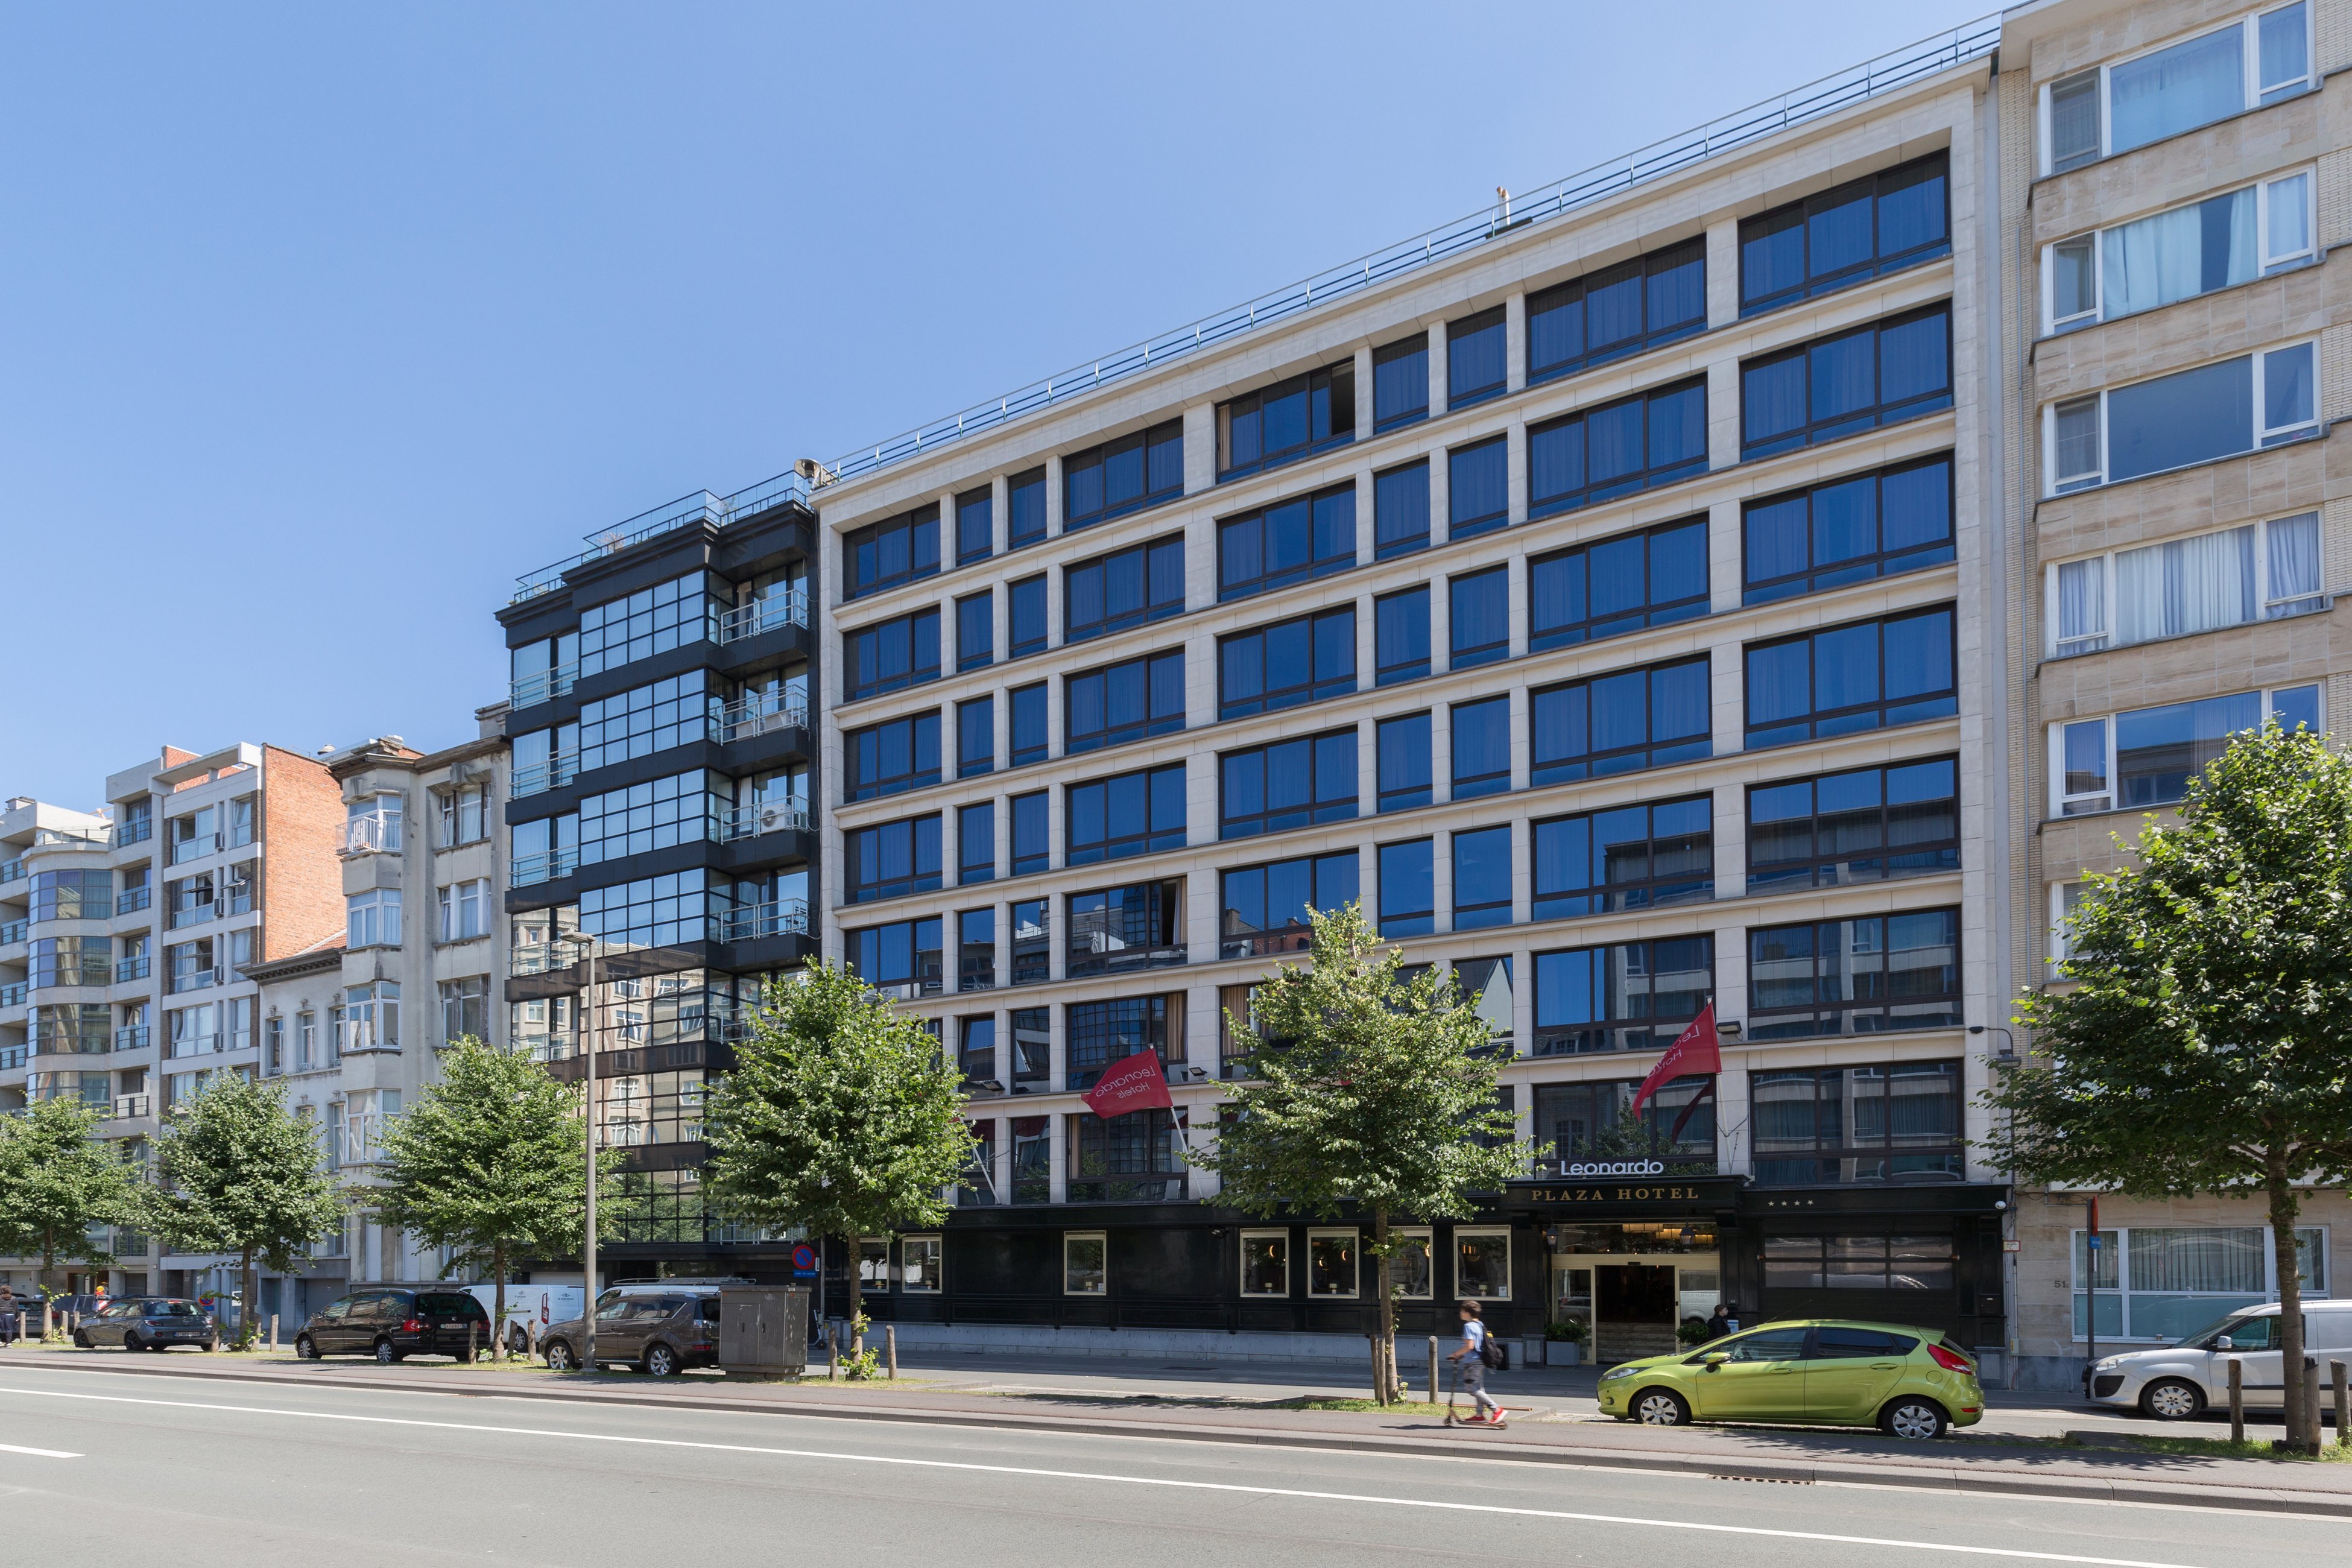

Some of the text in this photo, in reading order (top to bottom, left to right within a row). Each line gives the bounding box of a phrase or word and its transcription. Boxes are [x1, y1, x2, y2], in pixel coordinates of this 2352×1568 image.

[1561, 1159, 1664, 1175] Leonardo
[1532, 1188, 1698, 1201] PLAZA HOTEL
